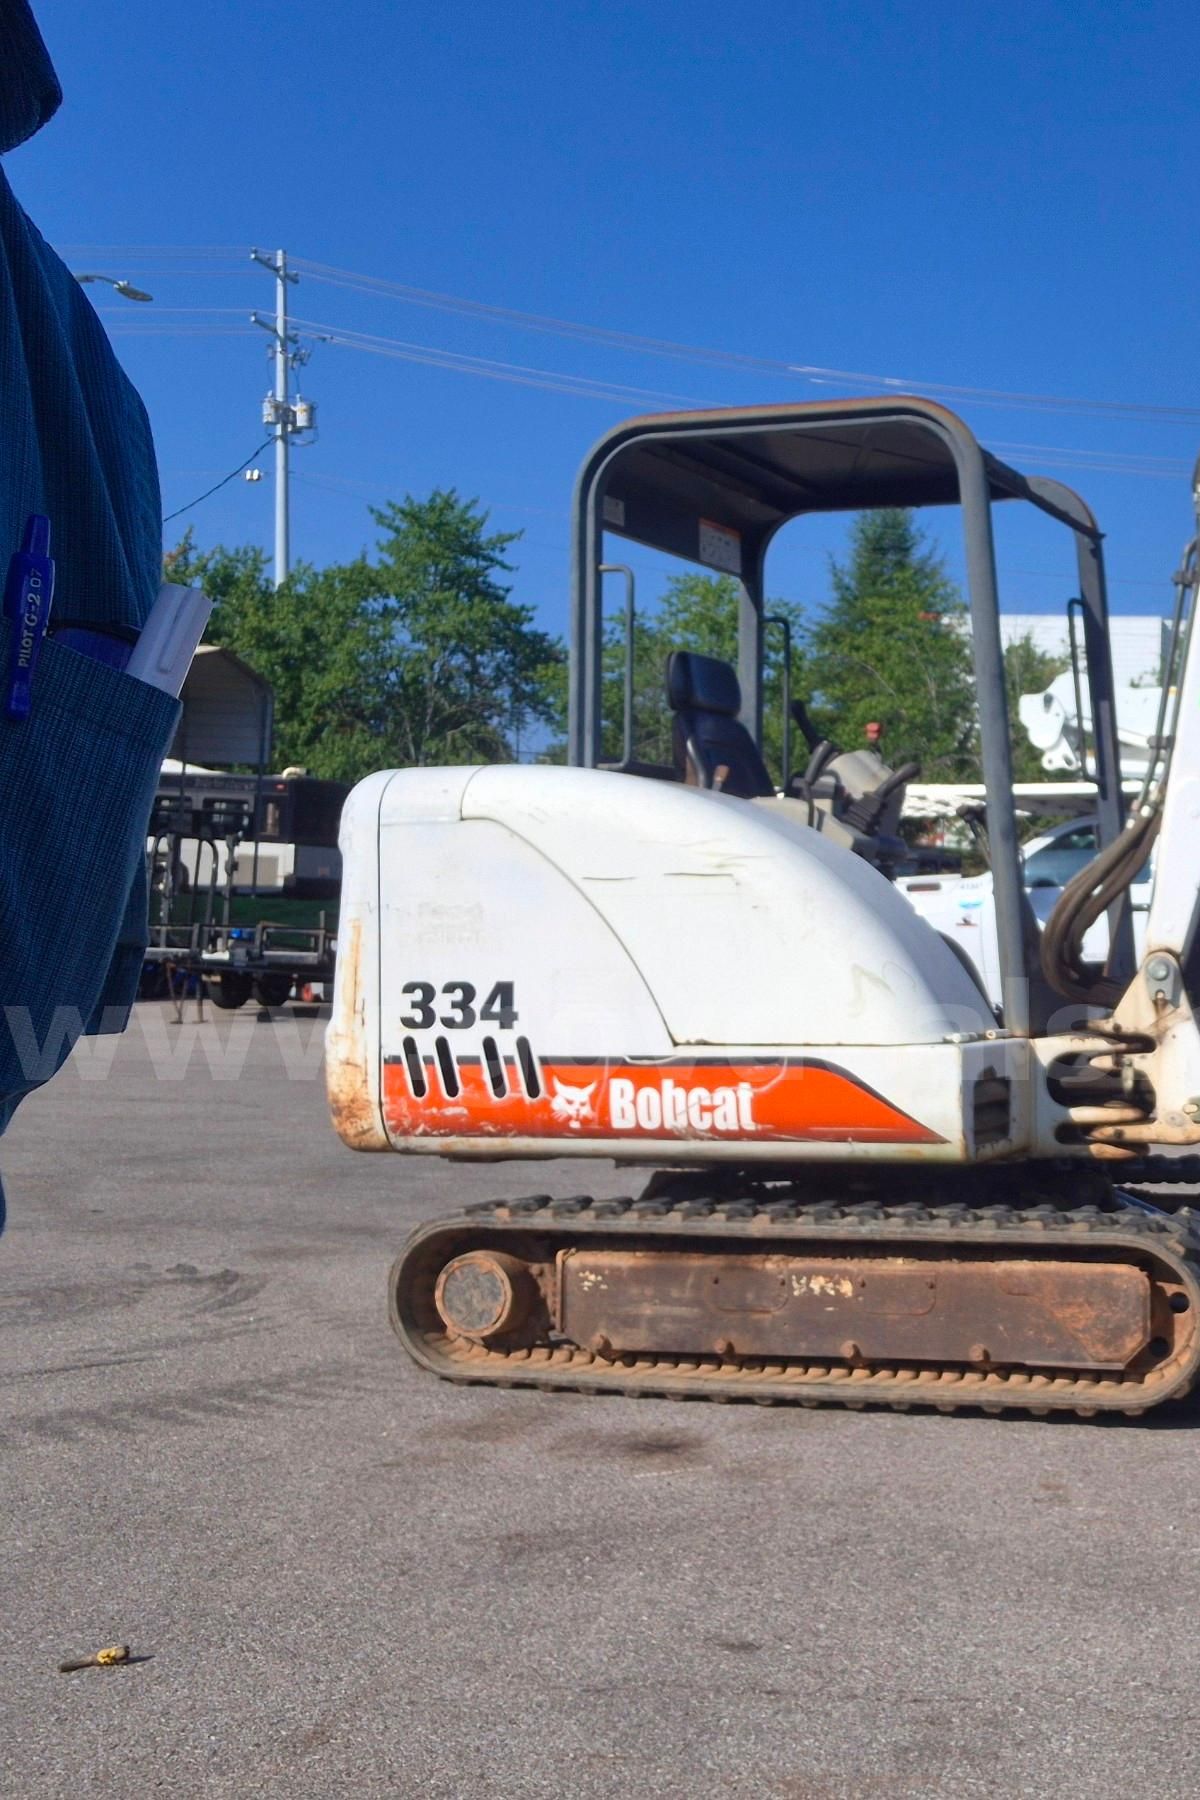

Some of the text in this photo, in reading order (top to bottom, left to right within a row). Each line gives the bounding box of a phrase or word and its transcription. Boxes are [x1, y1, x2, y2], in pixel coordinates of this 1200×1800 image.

[25, 593, 41, 626] G-2
[18, 629, 34, 668] PILOT
[400, 981, 519, 1030] 334
[609, 1078, 757, 1130] Bobcat
